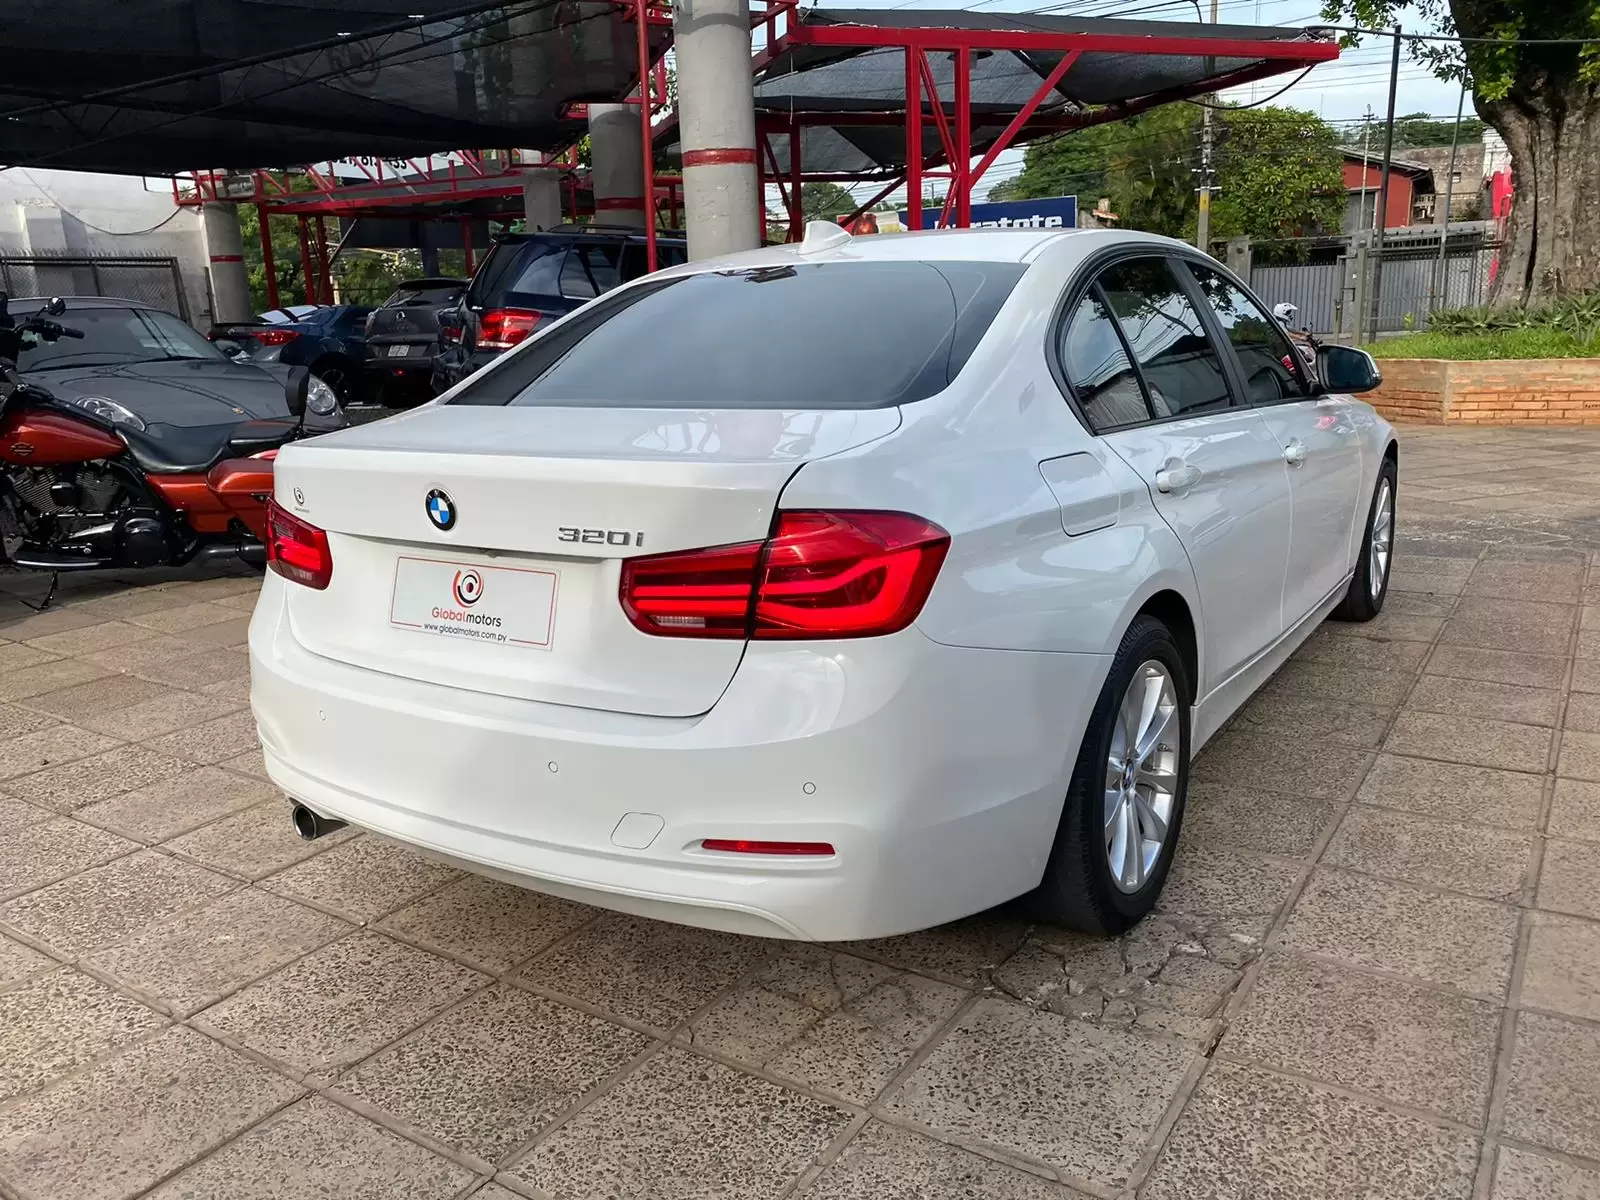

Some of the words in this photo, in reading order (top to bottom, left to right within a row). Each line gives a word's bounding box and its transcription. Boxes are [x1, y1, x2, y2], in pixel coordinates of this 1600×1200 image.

[558, 527, 644, 547] 320i
[431, 606, 502, 628] Globalmotors
[424, 622, 507, 642] www.globalmotors.com.py
